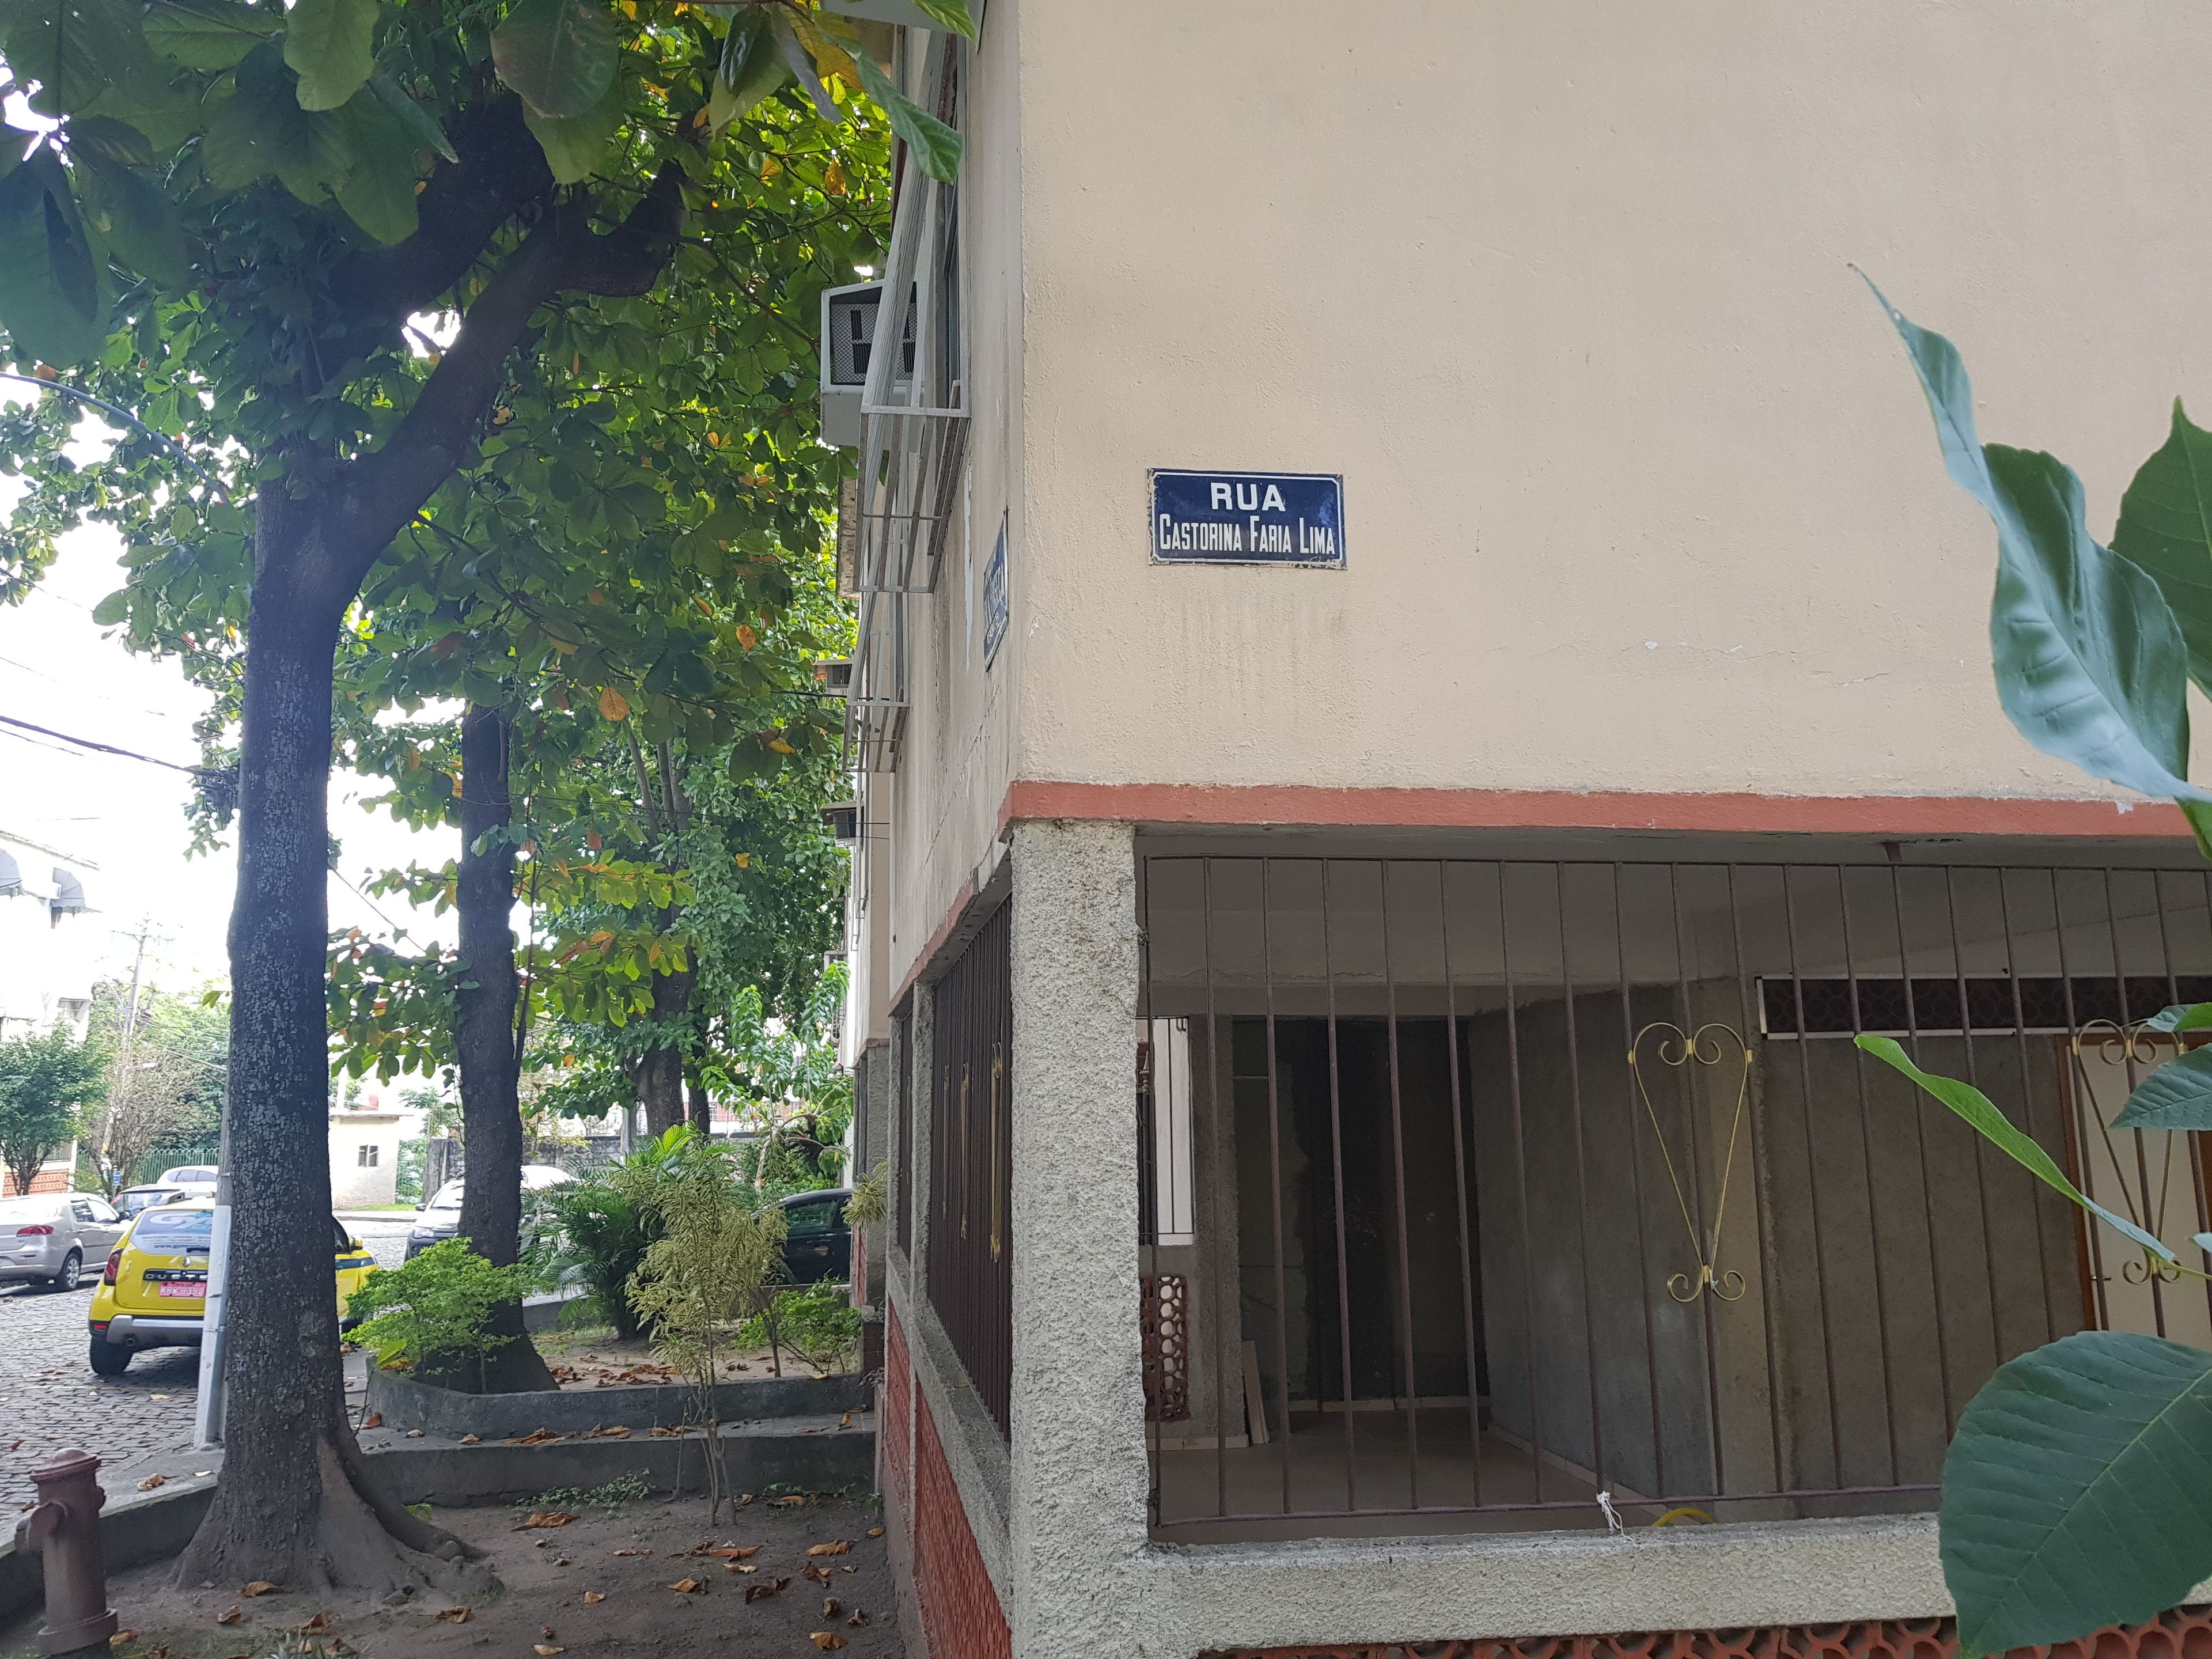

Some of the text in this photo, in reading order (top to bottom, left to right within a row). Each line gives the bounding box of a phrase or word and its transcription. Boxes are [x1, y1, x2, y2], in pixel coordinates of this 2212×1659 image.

[1210, 482, 1286, 512] RUA
[1159, 513, 1335, 554] CASTORINA FARIA LIMA
